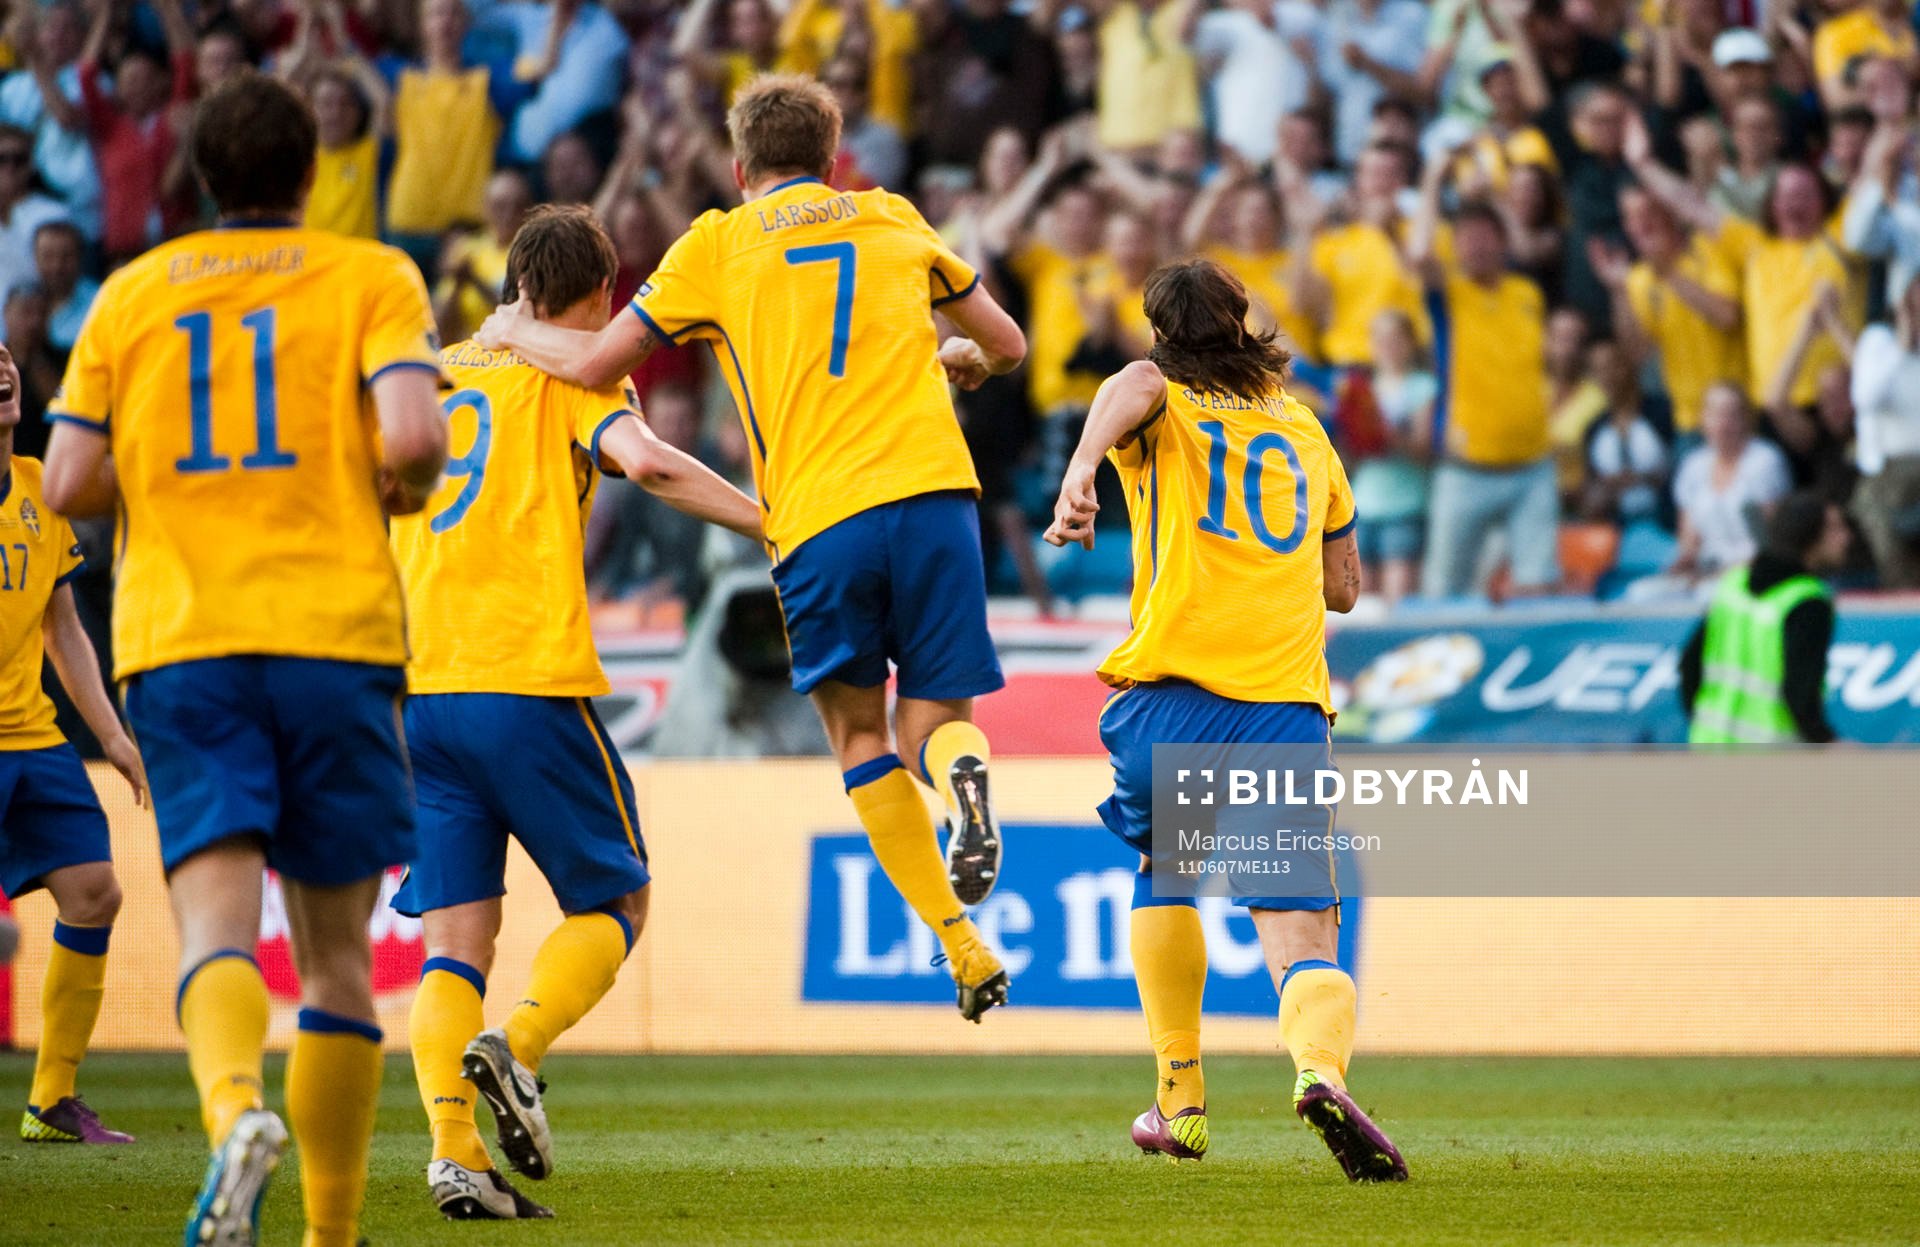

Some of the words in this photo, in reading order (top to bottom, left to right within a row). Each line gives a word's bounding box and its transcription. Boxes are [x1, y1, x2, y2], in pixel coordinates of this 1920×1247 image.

[757, 195, 859, 233] LARSSON
[784, 241, 856, 378] 7
[174, 308, 298, 472] 11
[430, 389, 492, 534] 9
[1197, 420, 1309, 555] 10
[0, 543, 28, 591] 17
